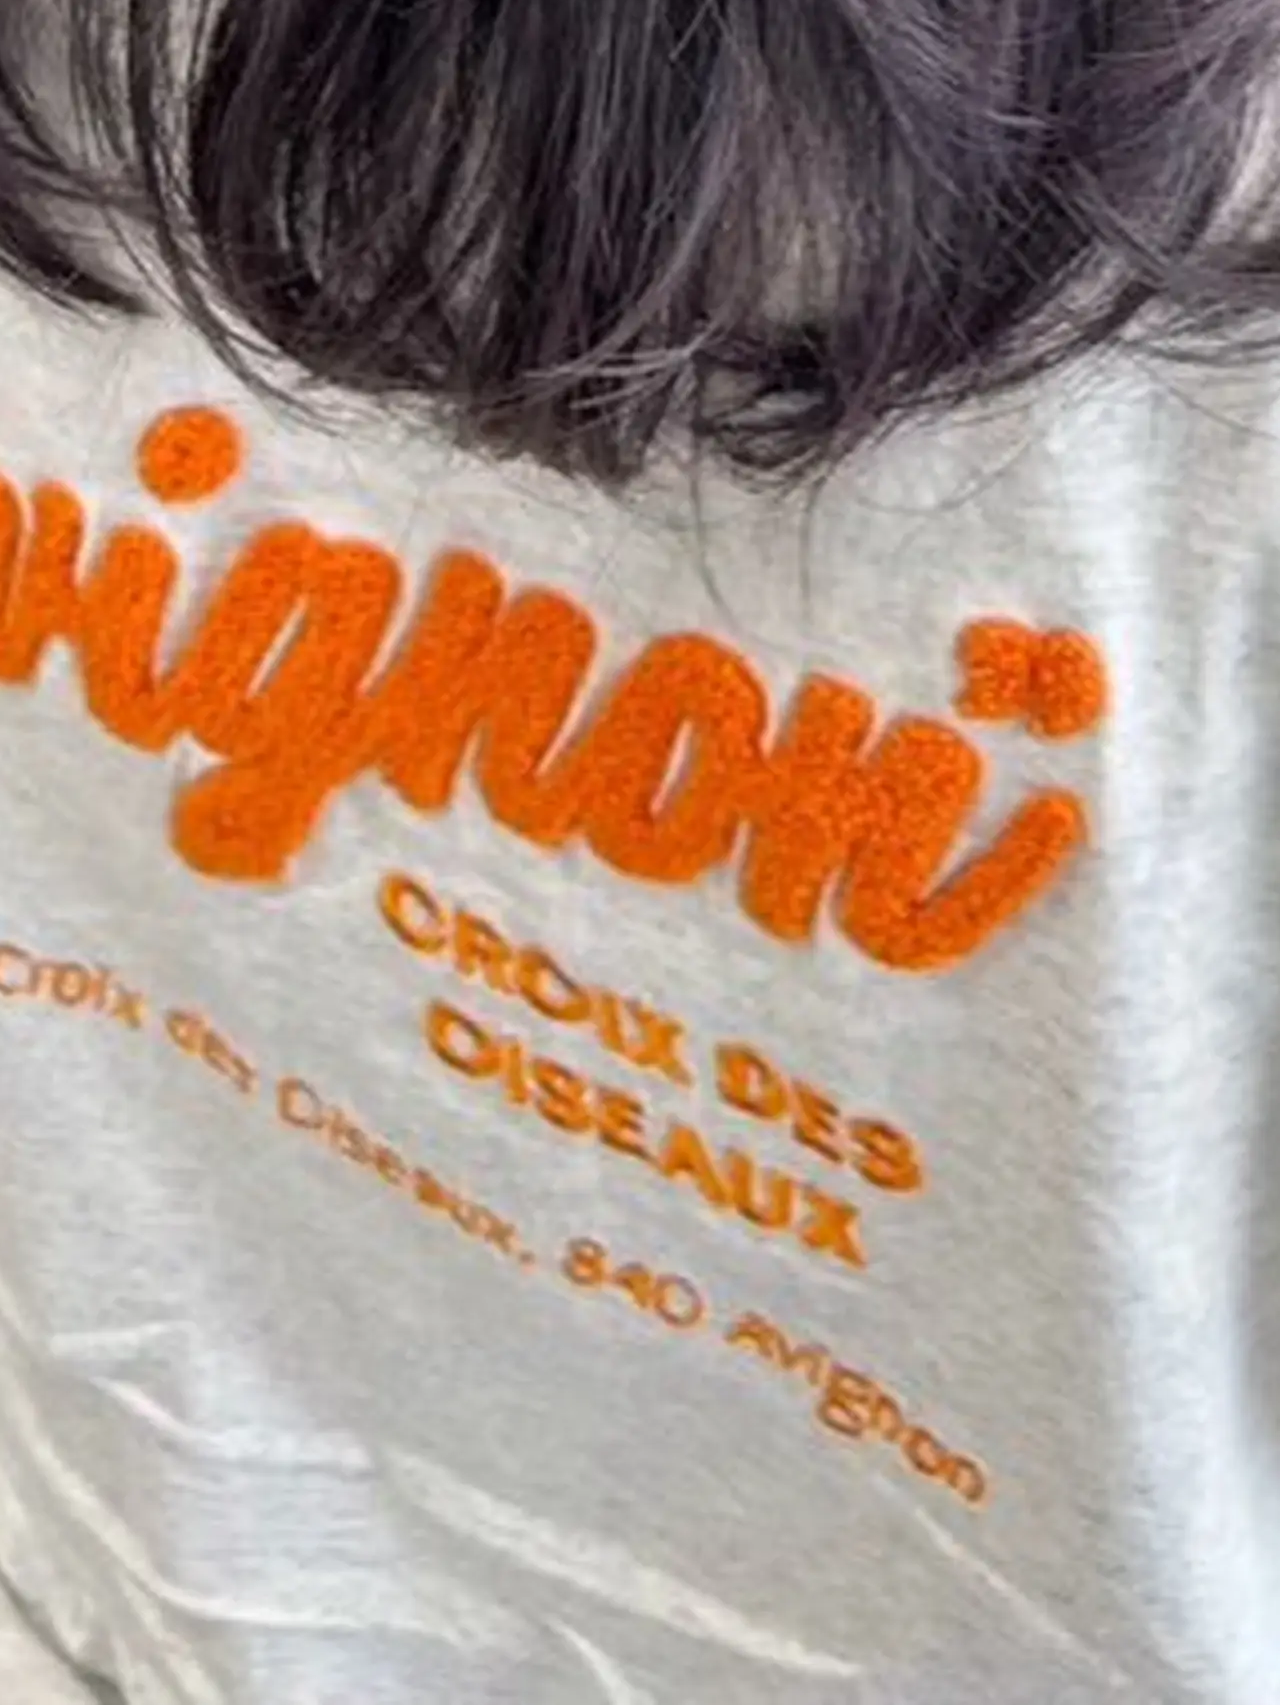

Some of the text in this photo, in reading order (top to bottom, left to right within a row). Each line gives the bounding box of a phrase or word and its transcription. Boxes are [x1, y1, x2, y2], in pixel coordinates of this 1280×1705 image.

[379, 873, 923, 1192] CROIX DES
[426, 999, 867, 1268] OISEAUX
